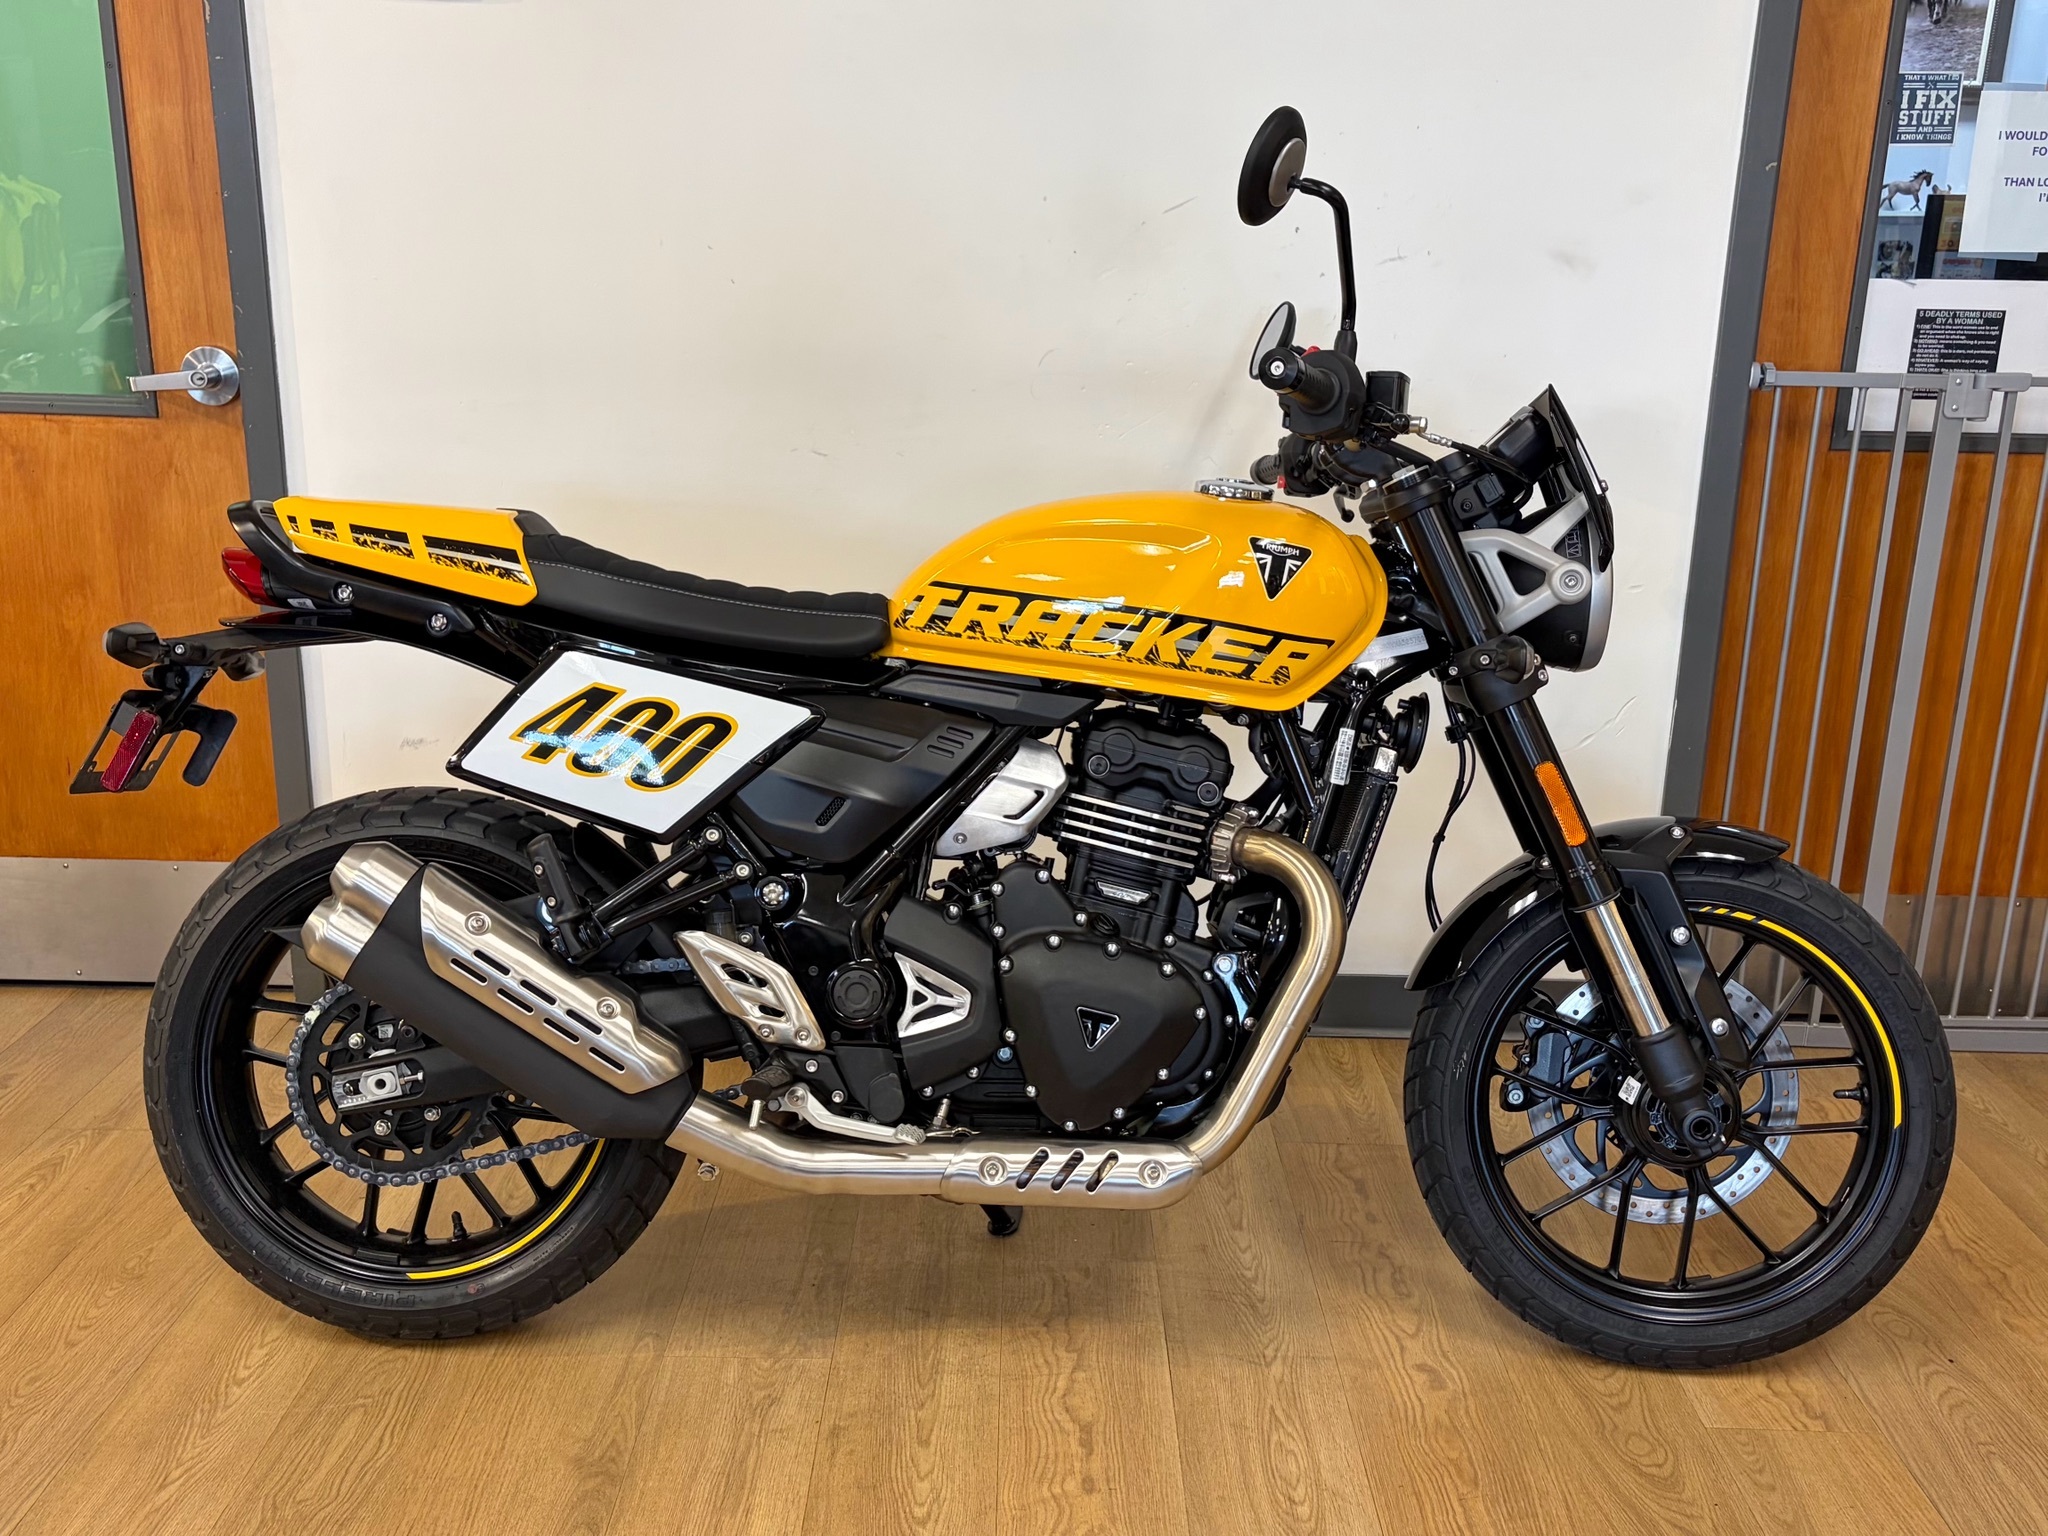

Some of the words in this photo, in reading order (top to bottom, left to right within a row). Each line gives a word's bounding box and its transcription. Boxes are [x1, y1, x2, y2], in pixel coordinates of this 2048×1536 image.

[1900, 90, 1910, 109] I
[1914, 90, 1958, 109] FIX
[1898, 110, 1955, 126] STUFF
[1896, 133, 1900, 141] I
[1900, 133, 1925, 141] KNOW
[1926, 133, 1952, 141] THINGS
[1998, 130, 2003, 141] I
[2003, 177, 2035, 187] THAN
[1925, 310, 1954, 318] DEADLY
[1982, 311, 2003, 319] USED
[1261, 543, 1300, 557] TRIUMPH
[903, 585, 1331, 683] TRACKER
[511, 681, 739, 793] 400
